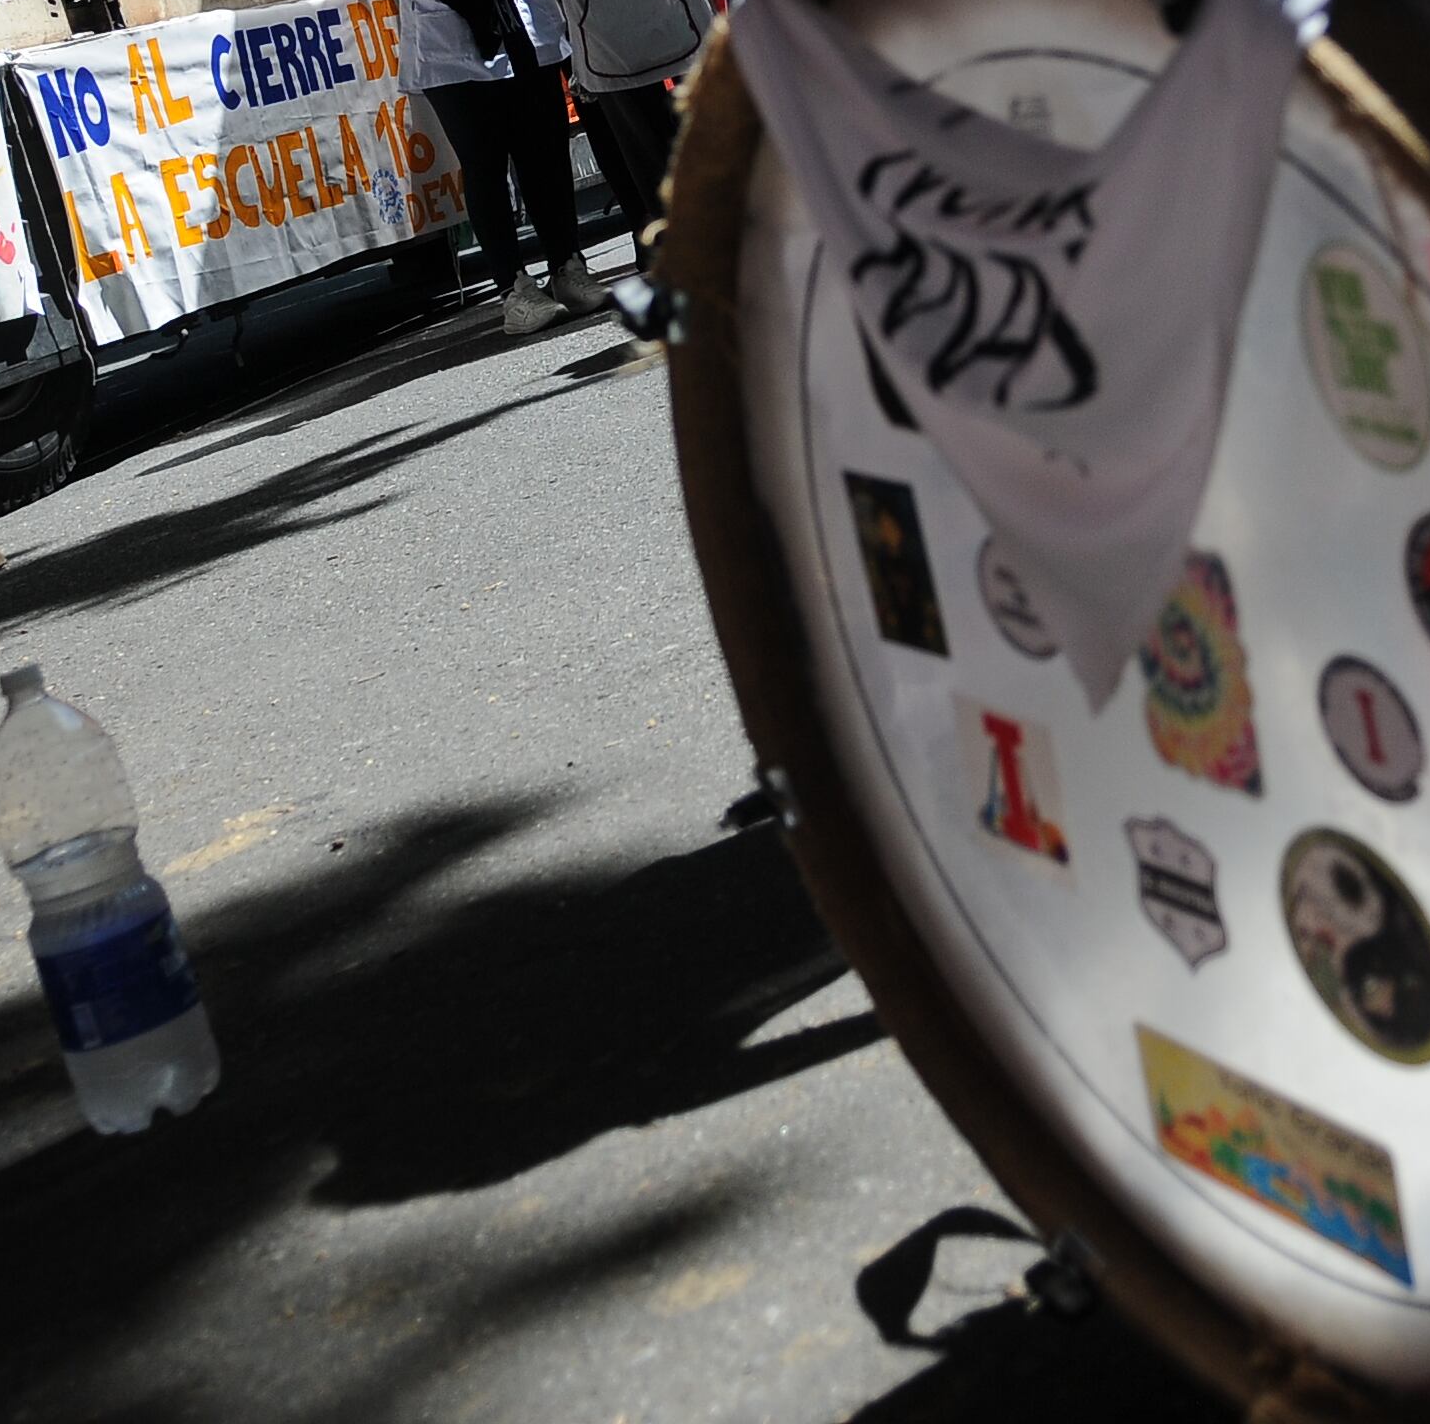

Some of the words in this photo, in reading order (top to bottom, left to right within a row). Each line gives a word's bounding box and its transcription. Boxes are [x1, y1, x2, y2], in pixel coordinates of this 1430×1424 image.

[38, 66, 111, 159] NO
[126, 37, 193, 135] AL
[211, 8, 356, 111] CIERRE
[65, 171, 154, 284] LA
[159, 114, 370, 248] ESCUELA
[375, 95, 436, 180] 16
